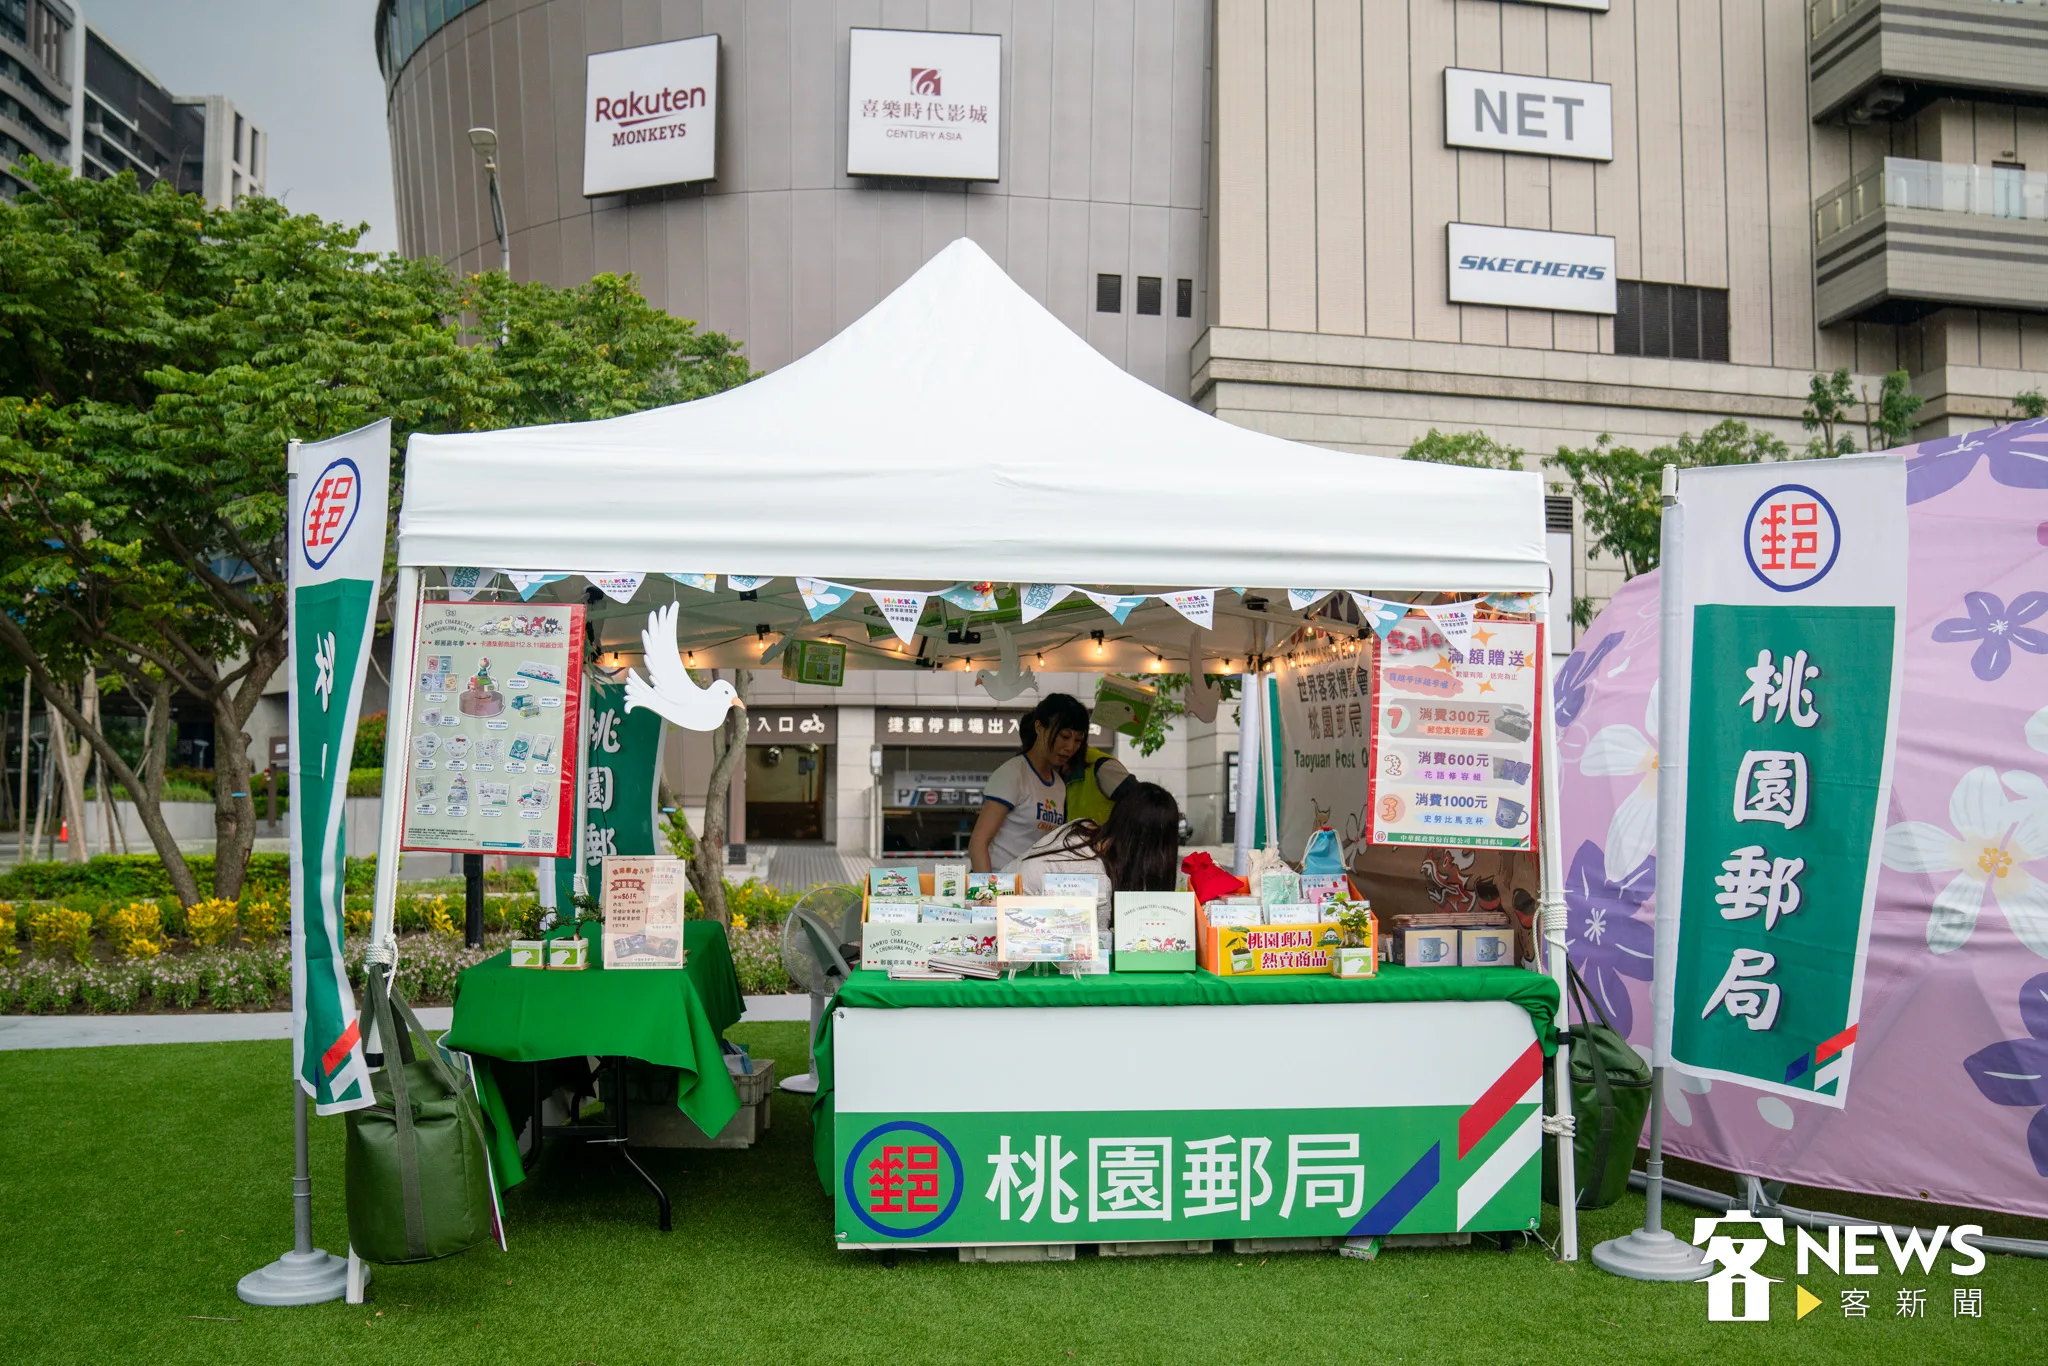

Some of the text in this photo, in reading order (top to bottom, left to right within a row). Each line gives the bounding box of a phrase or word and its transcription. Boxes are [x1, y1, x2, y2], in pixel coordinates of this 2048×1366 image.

[595, 86, 706, 123] Rakuten
[860, 98, 988, 124] 喜樂時代影城
[1474, 88, 1584, 141] NET
[611, 123, 687, 147] MONKEYS
[886, 129, 963, 141] CENTURY ASIA
[1458, 255, 1607, 281] SKECHERS
[1419, 707, 1490, 724] 消費300元
[1294, 749, 1331, 772] Taoyuan
[1336, 749, 1356, 768] Post
[1418, 751, 1490, 768] 消費600元
[1415, 792, 1488, 809] 消費1000元
[1036, 802, 1063, 825] Fanta
[1701, 648, 1821, 1033] 桃園郵局
[890, 938, 922, 950] CHARACTERS
[1246, 930, 1314, 950] 桃園郵局
[985, 1133, 1366, 1224] 桃園郵局
